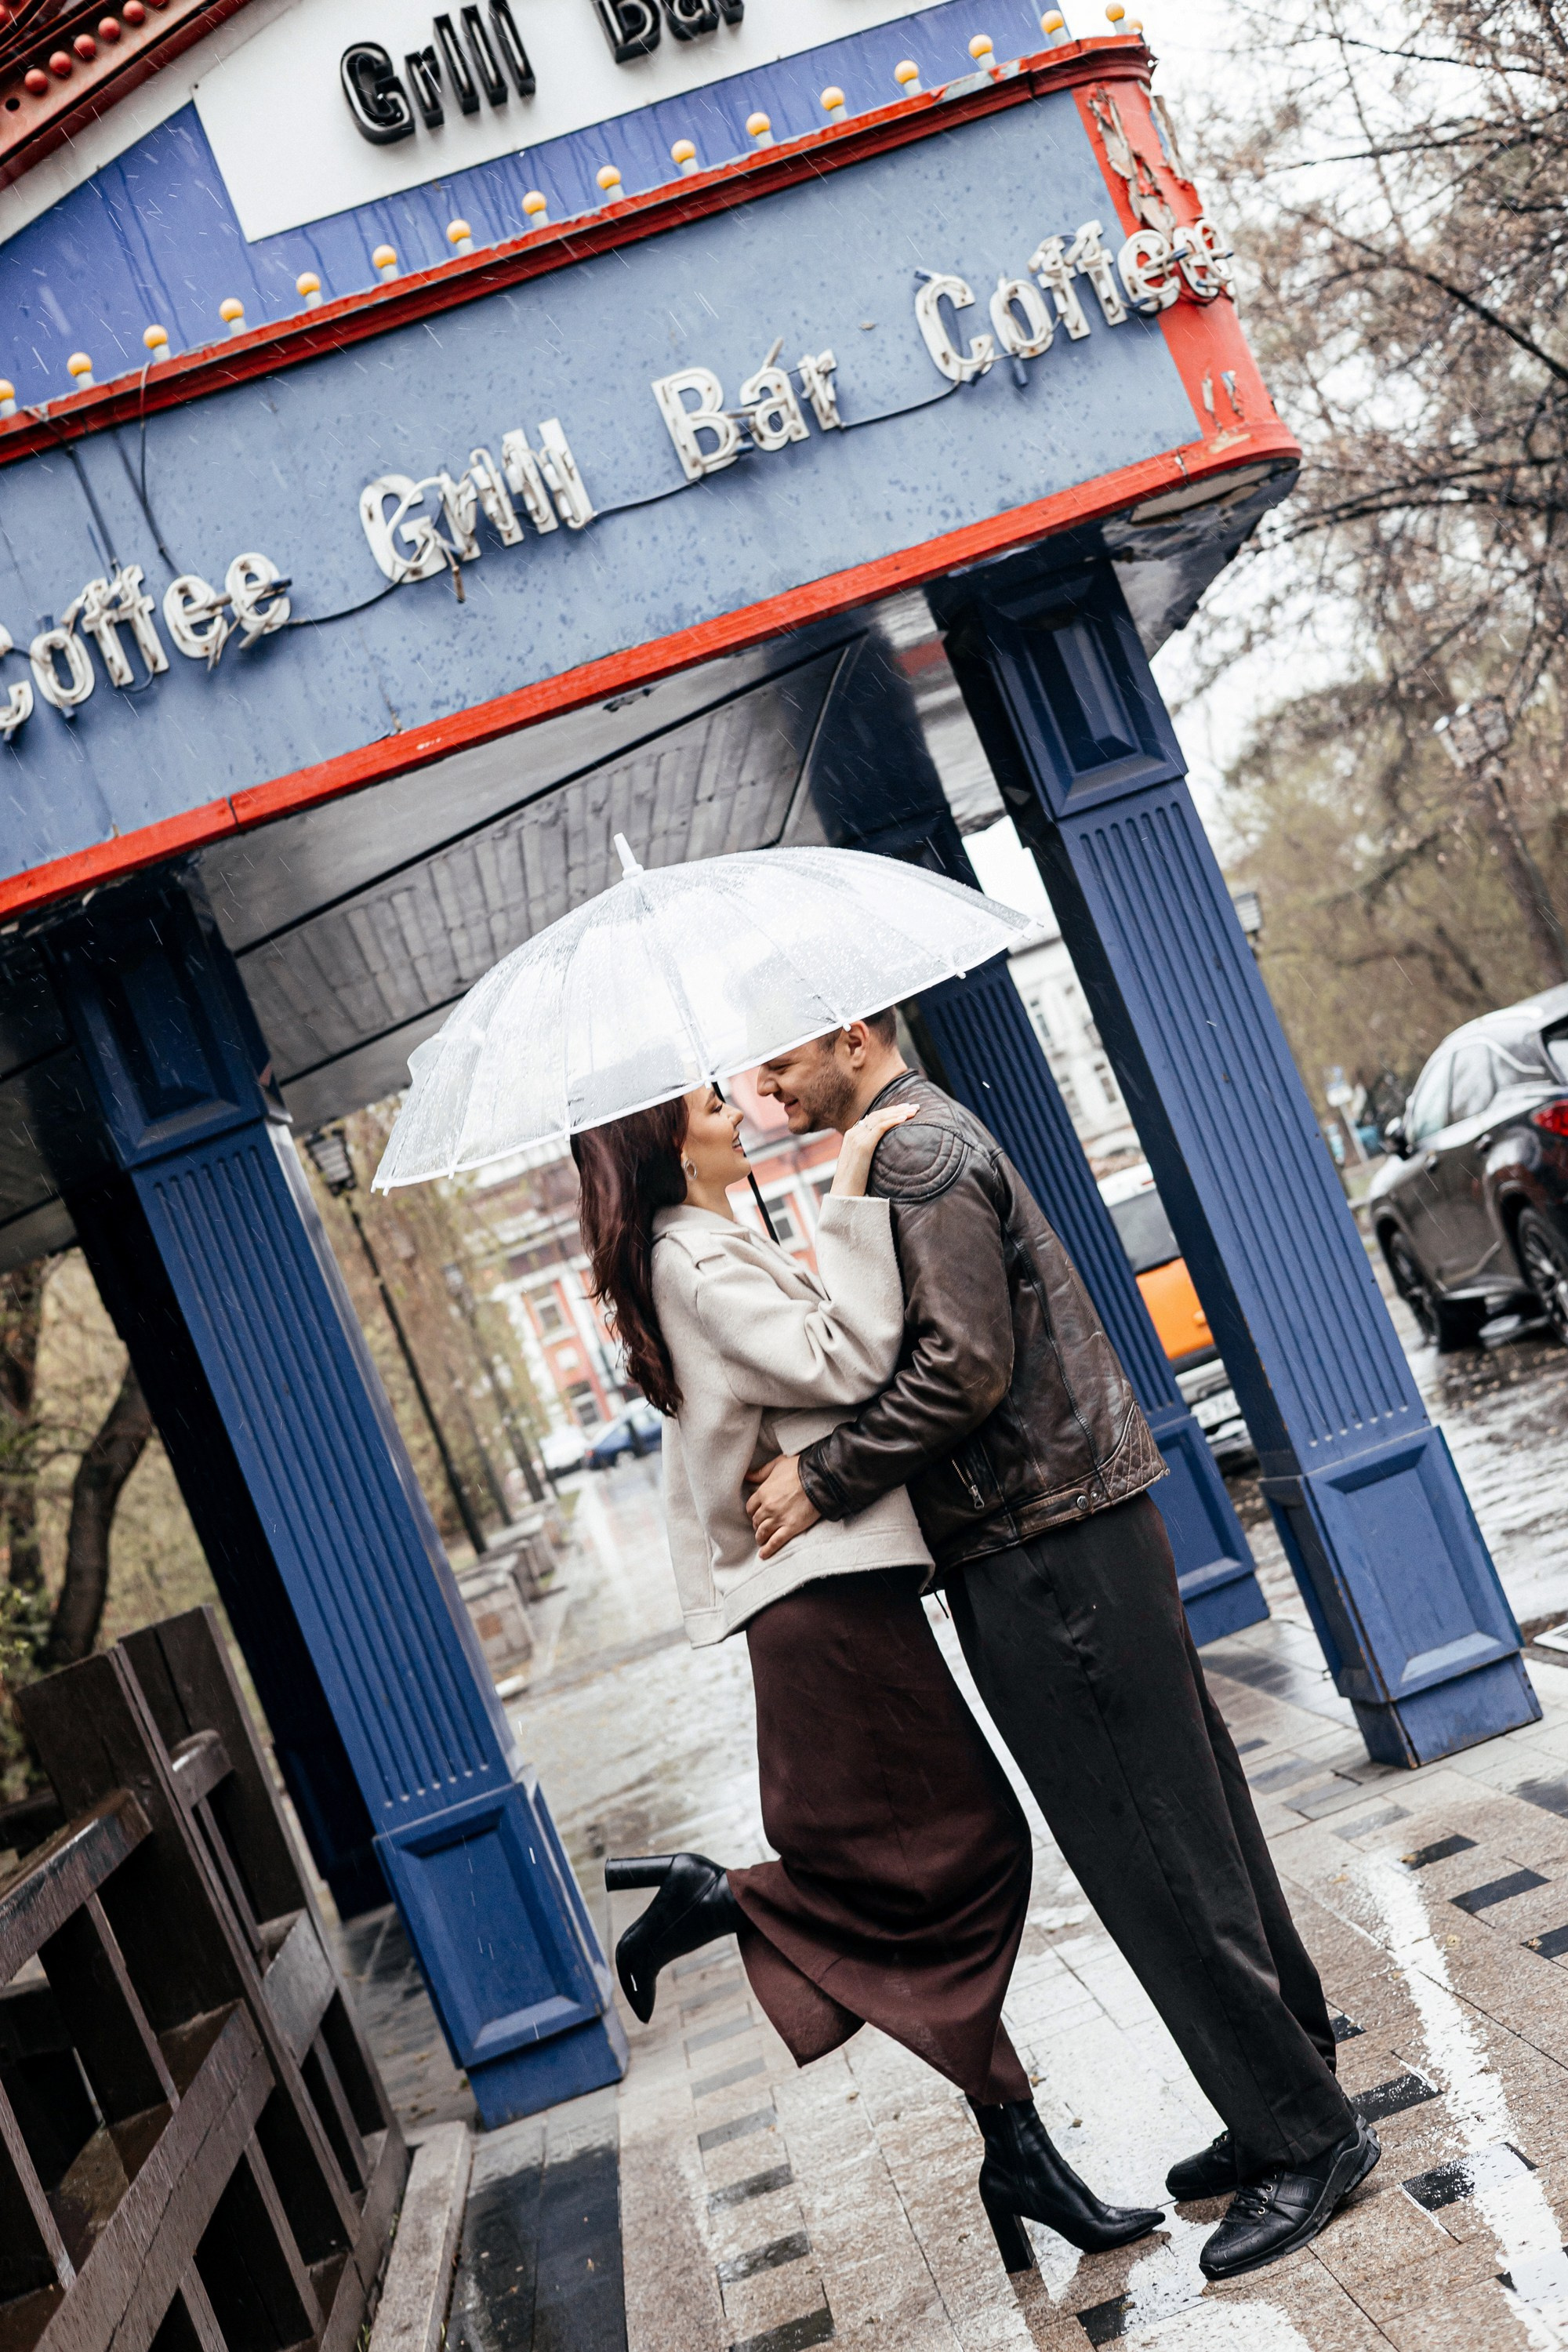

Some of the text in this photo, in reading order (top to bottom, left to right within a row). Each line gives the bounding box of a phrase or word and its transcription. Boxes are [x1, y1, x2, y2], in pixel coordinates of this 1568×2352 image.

[359, 417, 596, 584] Grill
[650, 348, 838, 481] Bar
[914, 218, 1235, 383] Coffee
